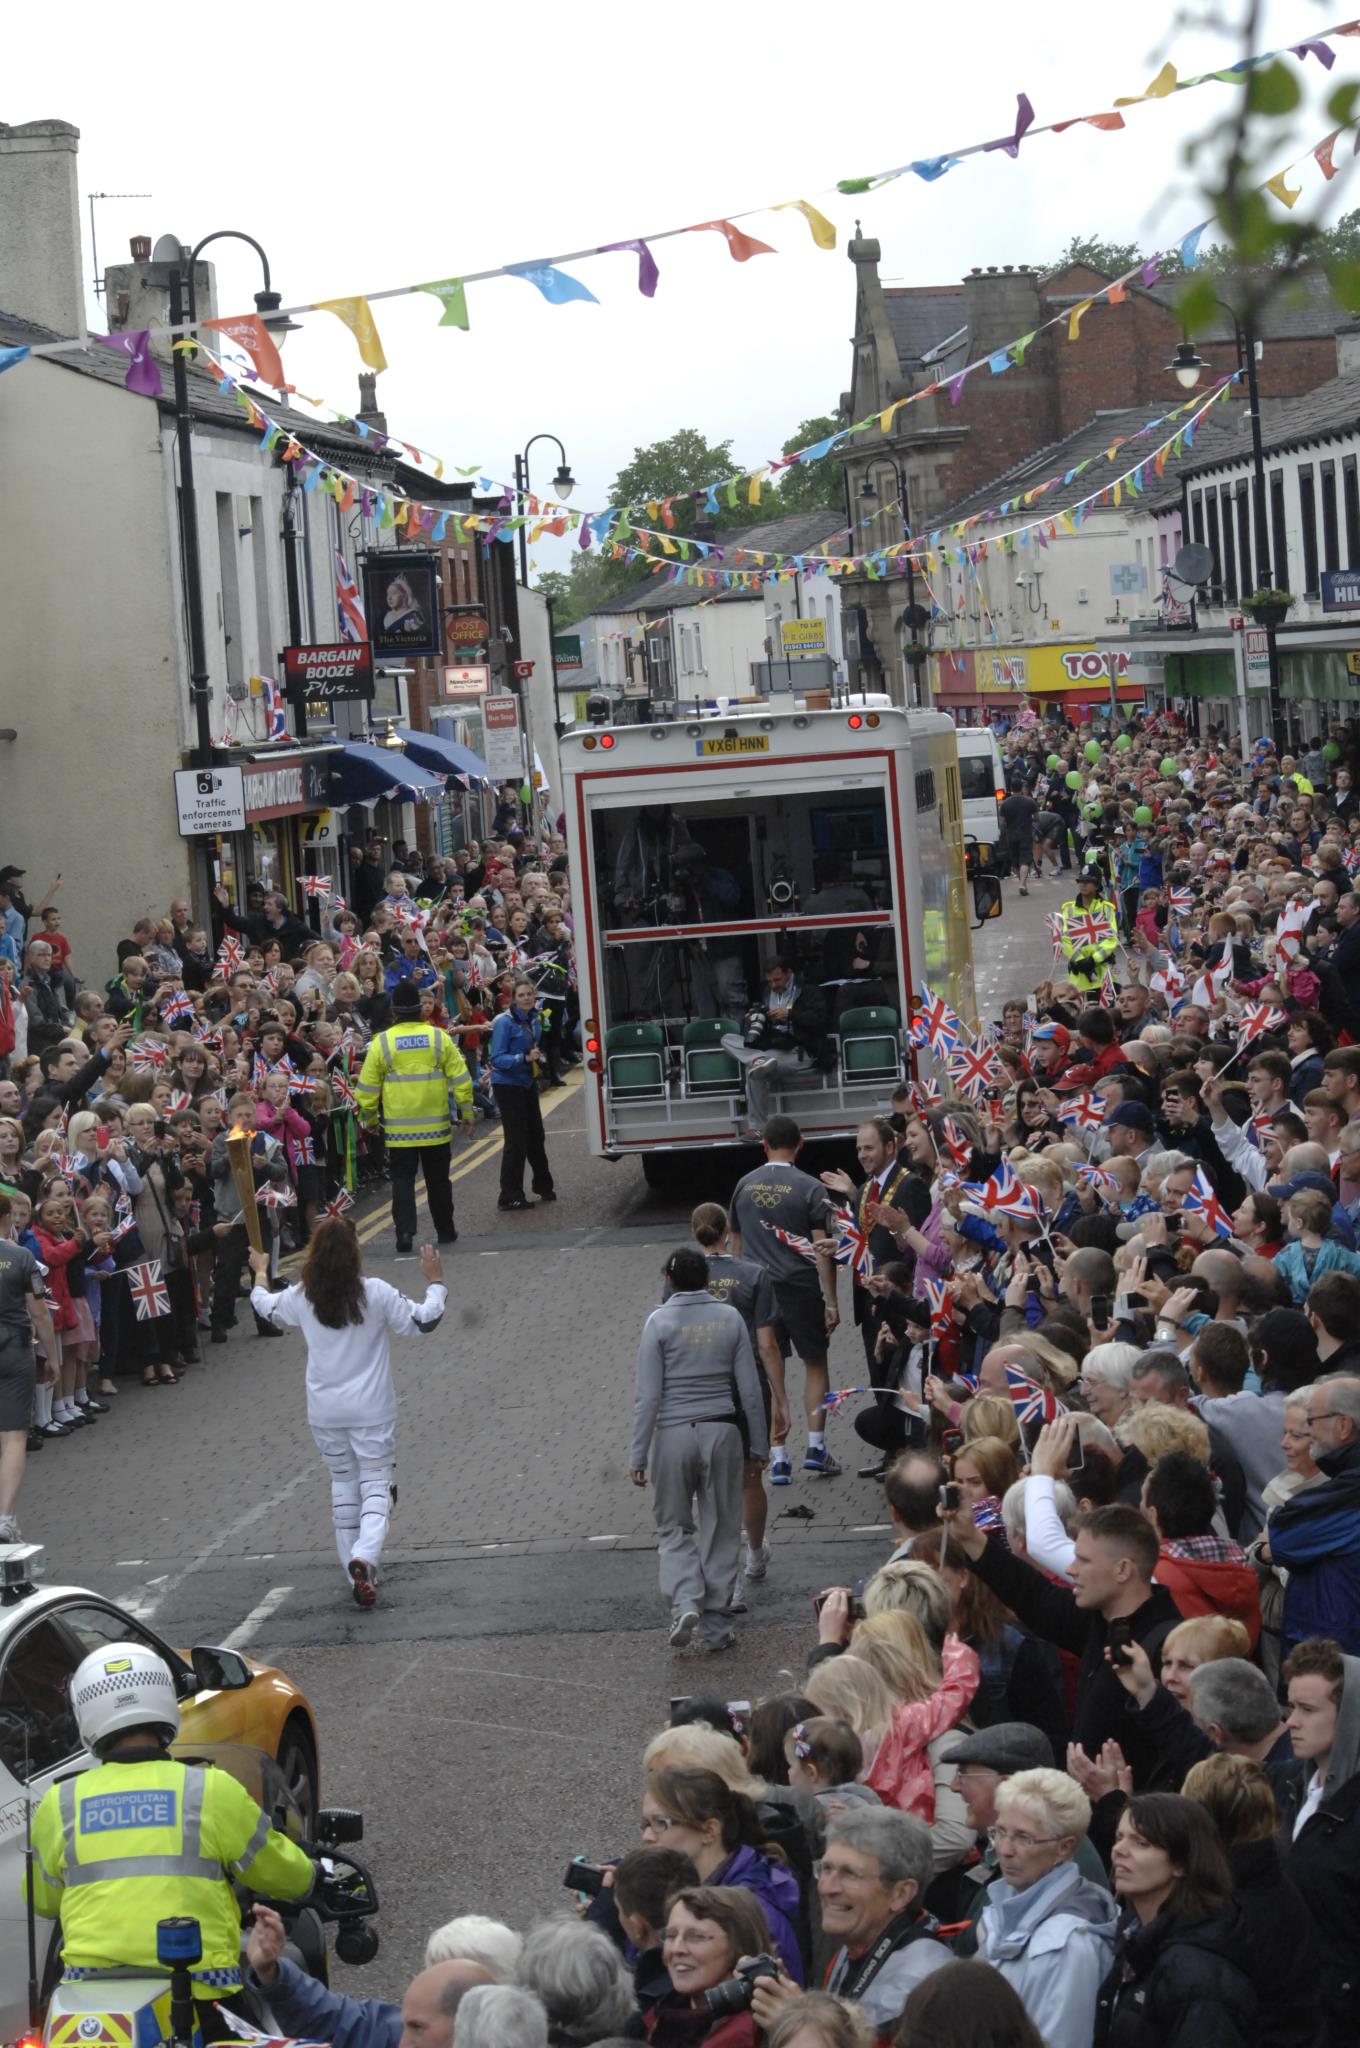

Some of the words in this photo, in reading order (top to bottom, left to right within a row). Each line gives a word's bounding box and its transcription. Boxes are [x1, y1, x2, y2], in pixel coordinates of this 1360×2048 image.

[456, 621, 479, 631] POST
[1051, 620, 1060, 630] H
[1234, 619, 1242, 629] F
[451, 630, 484, 640] OFFICE
[297, 649, 362, 665] BARGAIN
[306, 665, 355, 679] BOOZE
[518, 664, 529, 676] G
[500, 713, 515, 721] Stop
[708, 739, 736, 753] VX61
[739, 737, 764, 751] HNN
[196, 798, 226, 809] Traffic
[182, 808, 241, 820] enforcement
[193, 820, 232, 830] cameras
[396, 1036, 429, 1048] POLICE
[773, 1185, 792, 1194] 2012
[85, 1793, 168, 1809] METROPOLITAN
[85, 1804, 169, 1829] POLICE
